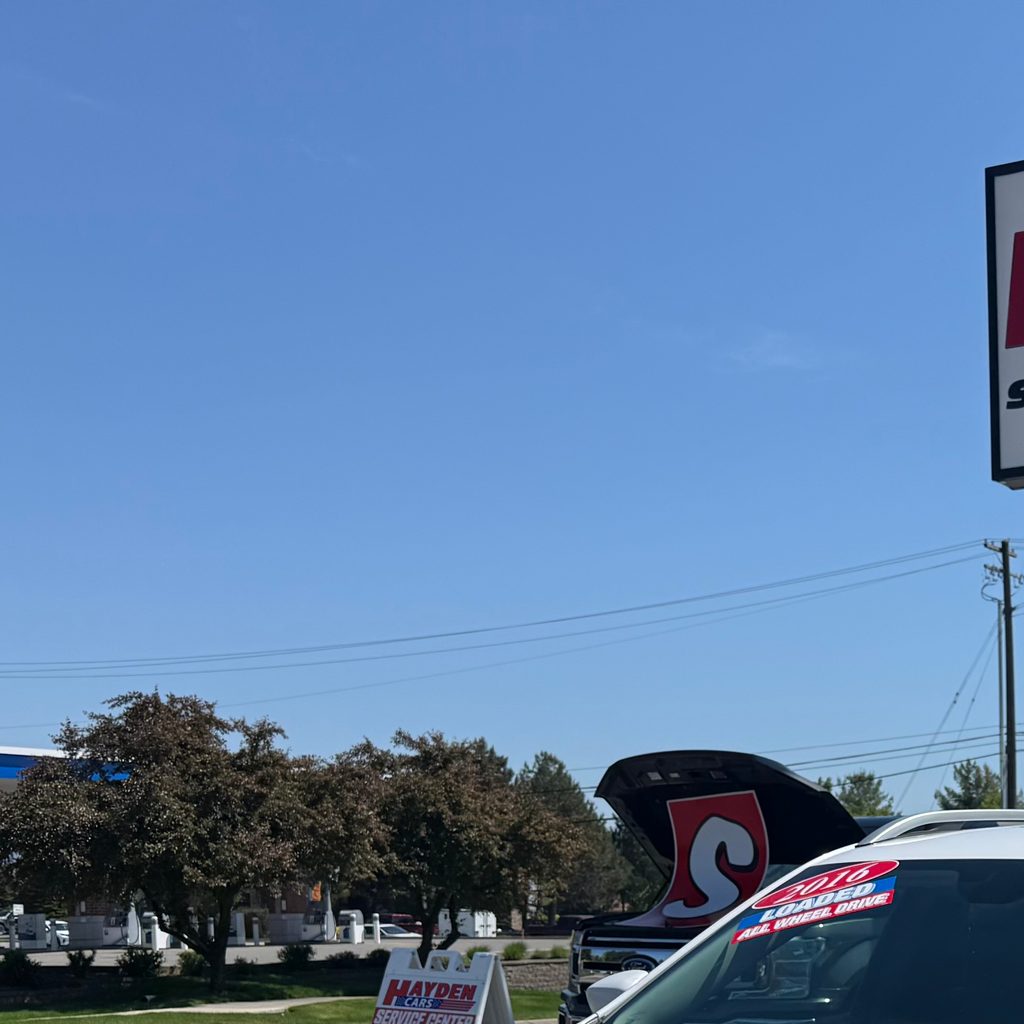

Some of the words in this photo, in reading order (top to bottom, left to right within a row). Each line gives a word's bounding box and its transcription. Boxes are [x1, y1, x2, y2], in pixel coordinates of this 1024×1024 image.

[758, 882, 877, 923] LOADED
[772, 862, 880, 904] 2016
[736, 922, 771, 941] ALL
[773, 906, 833, 930] WHEEL
[833, 892, 890, 915] DRIVE
[383, 979, 477, 1005] HAYDEN
[404, 997, 433, 1008] CARS
